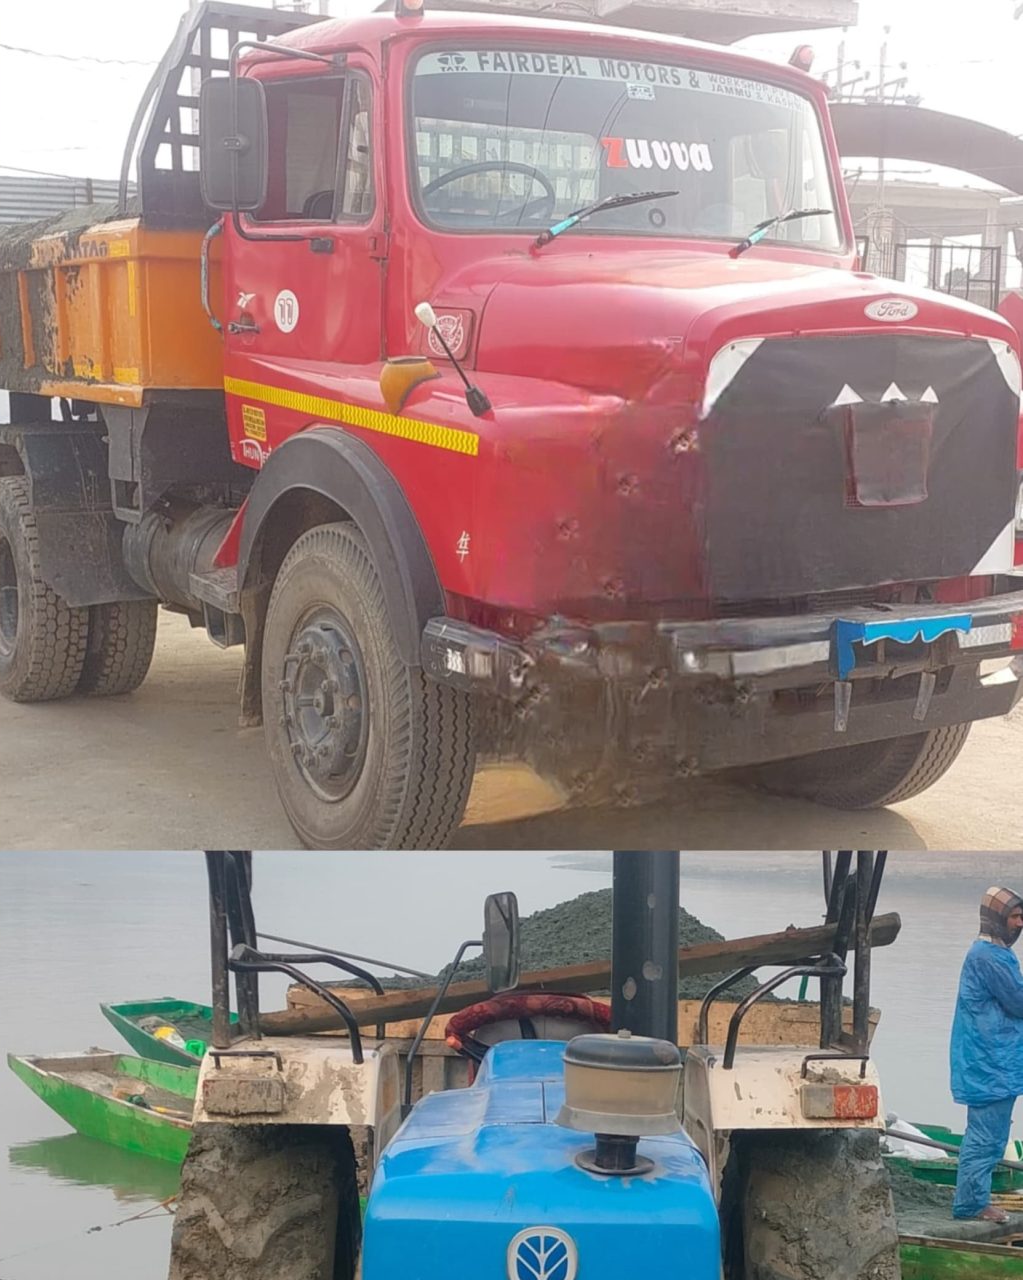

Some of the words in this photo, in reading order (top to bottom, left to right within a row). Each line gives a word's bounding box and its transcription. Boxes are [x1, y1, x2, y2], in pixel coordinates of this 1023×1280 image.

[478, 51, 588, 77] FAIRDEAL
[598, 59, 681, 86] MOTORS
[689, 71, 701, 89] &
[711, 84, 753, 98] JAMMU
[877, 301, 910, 317] Ford
